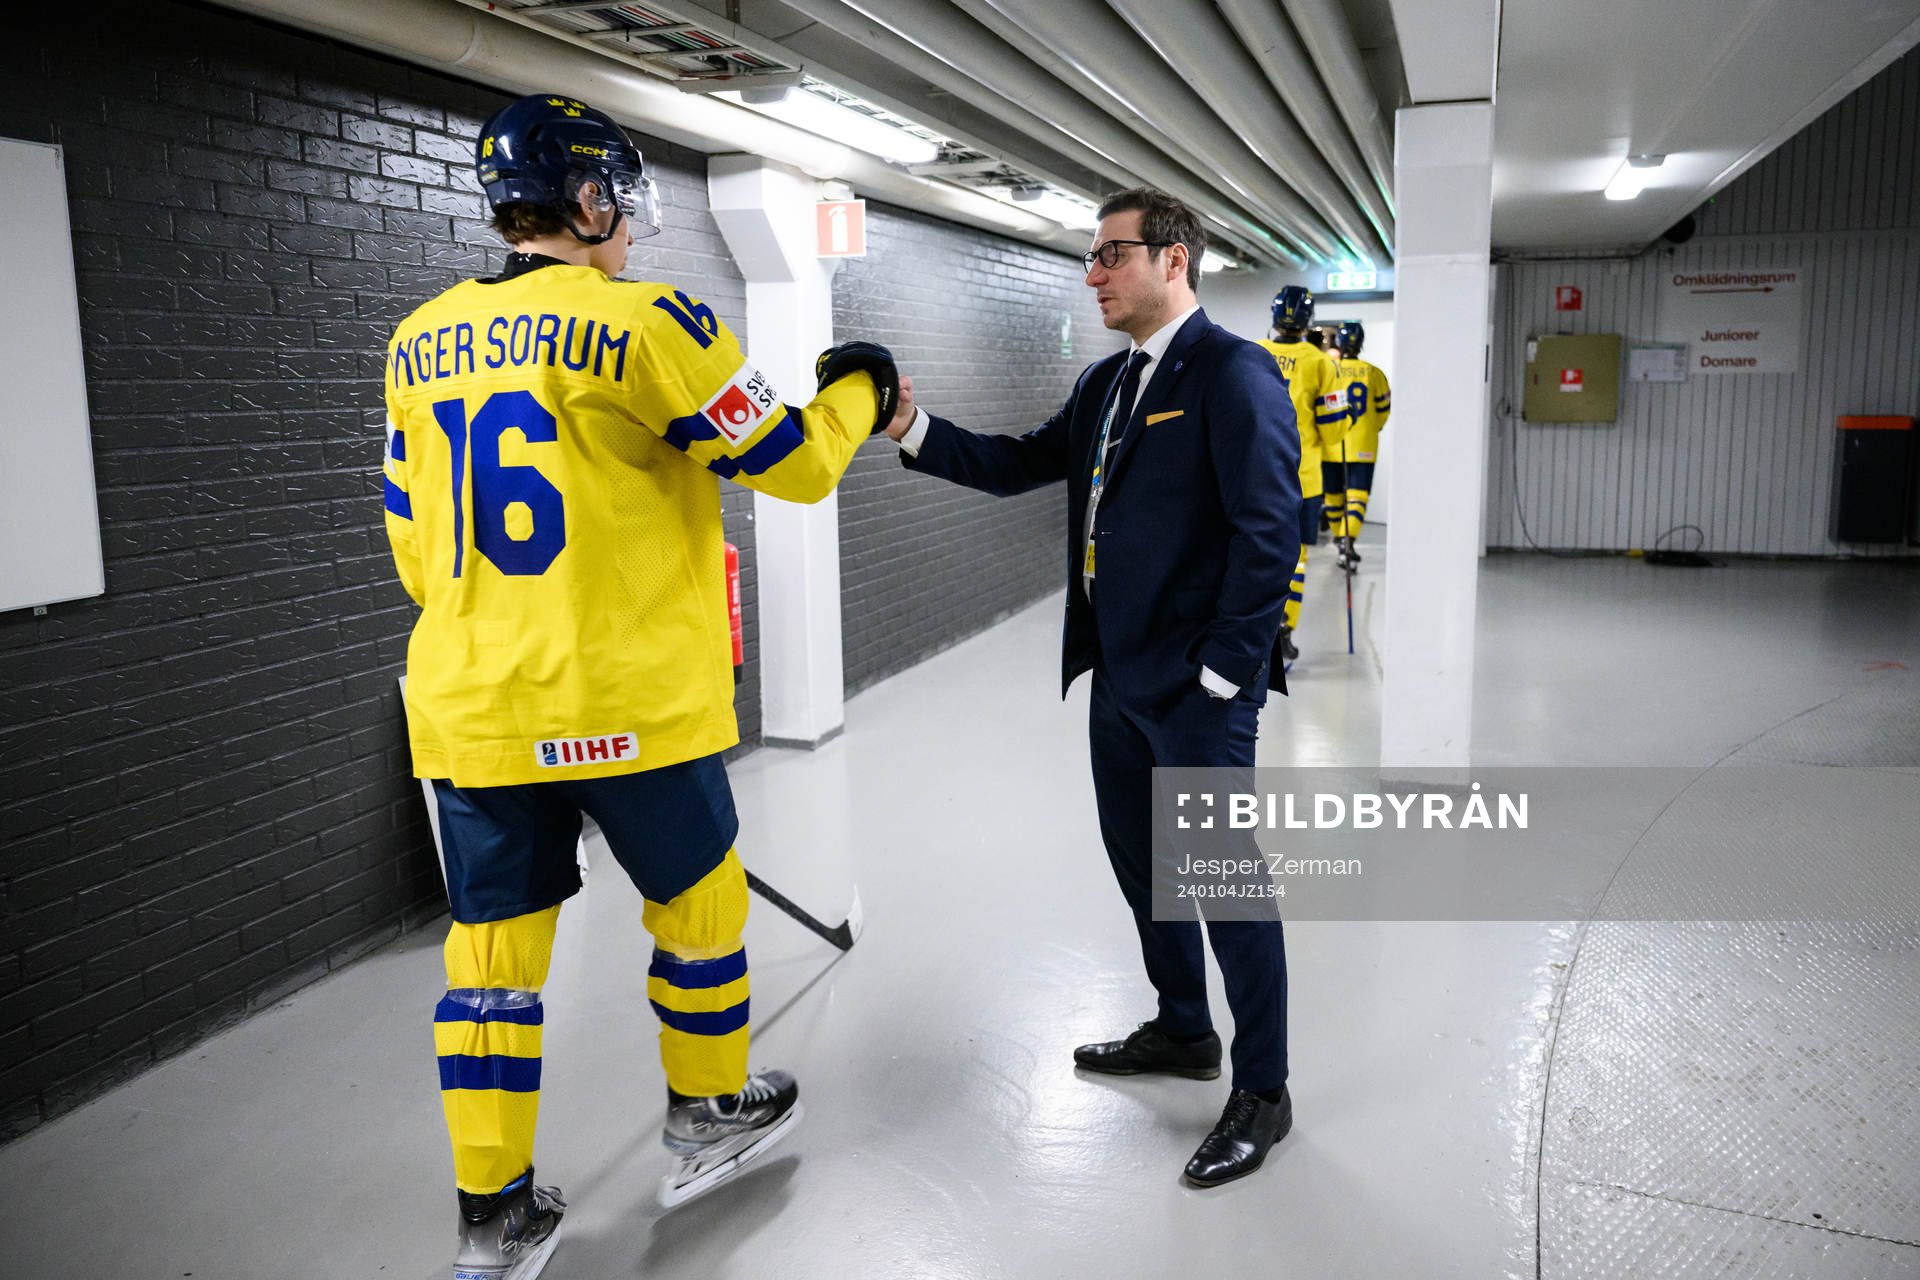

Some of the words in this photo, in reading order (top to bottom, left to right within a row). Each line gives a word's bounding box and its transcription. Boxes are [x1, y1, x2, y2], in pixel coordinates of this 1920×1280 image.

[482, 136, 495, 158] 16
[571, 144, 609, 157] CCM
[1673, 272, 1796, 287] Omklädningsrum
[652, 289, 719, 350] 16
[1701, 329, 1760, 342] Juniorer
[485, 313, 630, 383] SORUM
[1701, 355, 1757, 368] Domare
[432, 389, 567, 578] 16
[562, 736, 630, 763] IIHF
